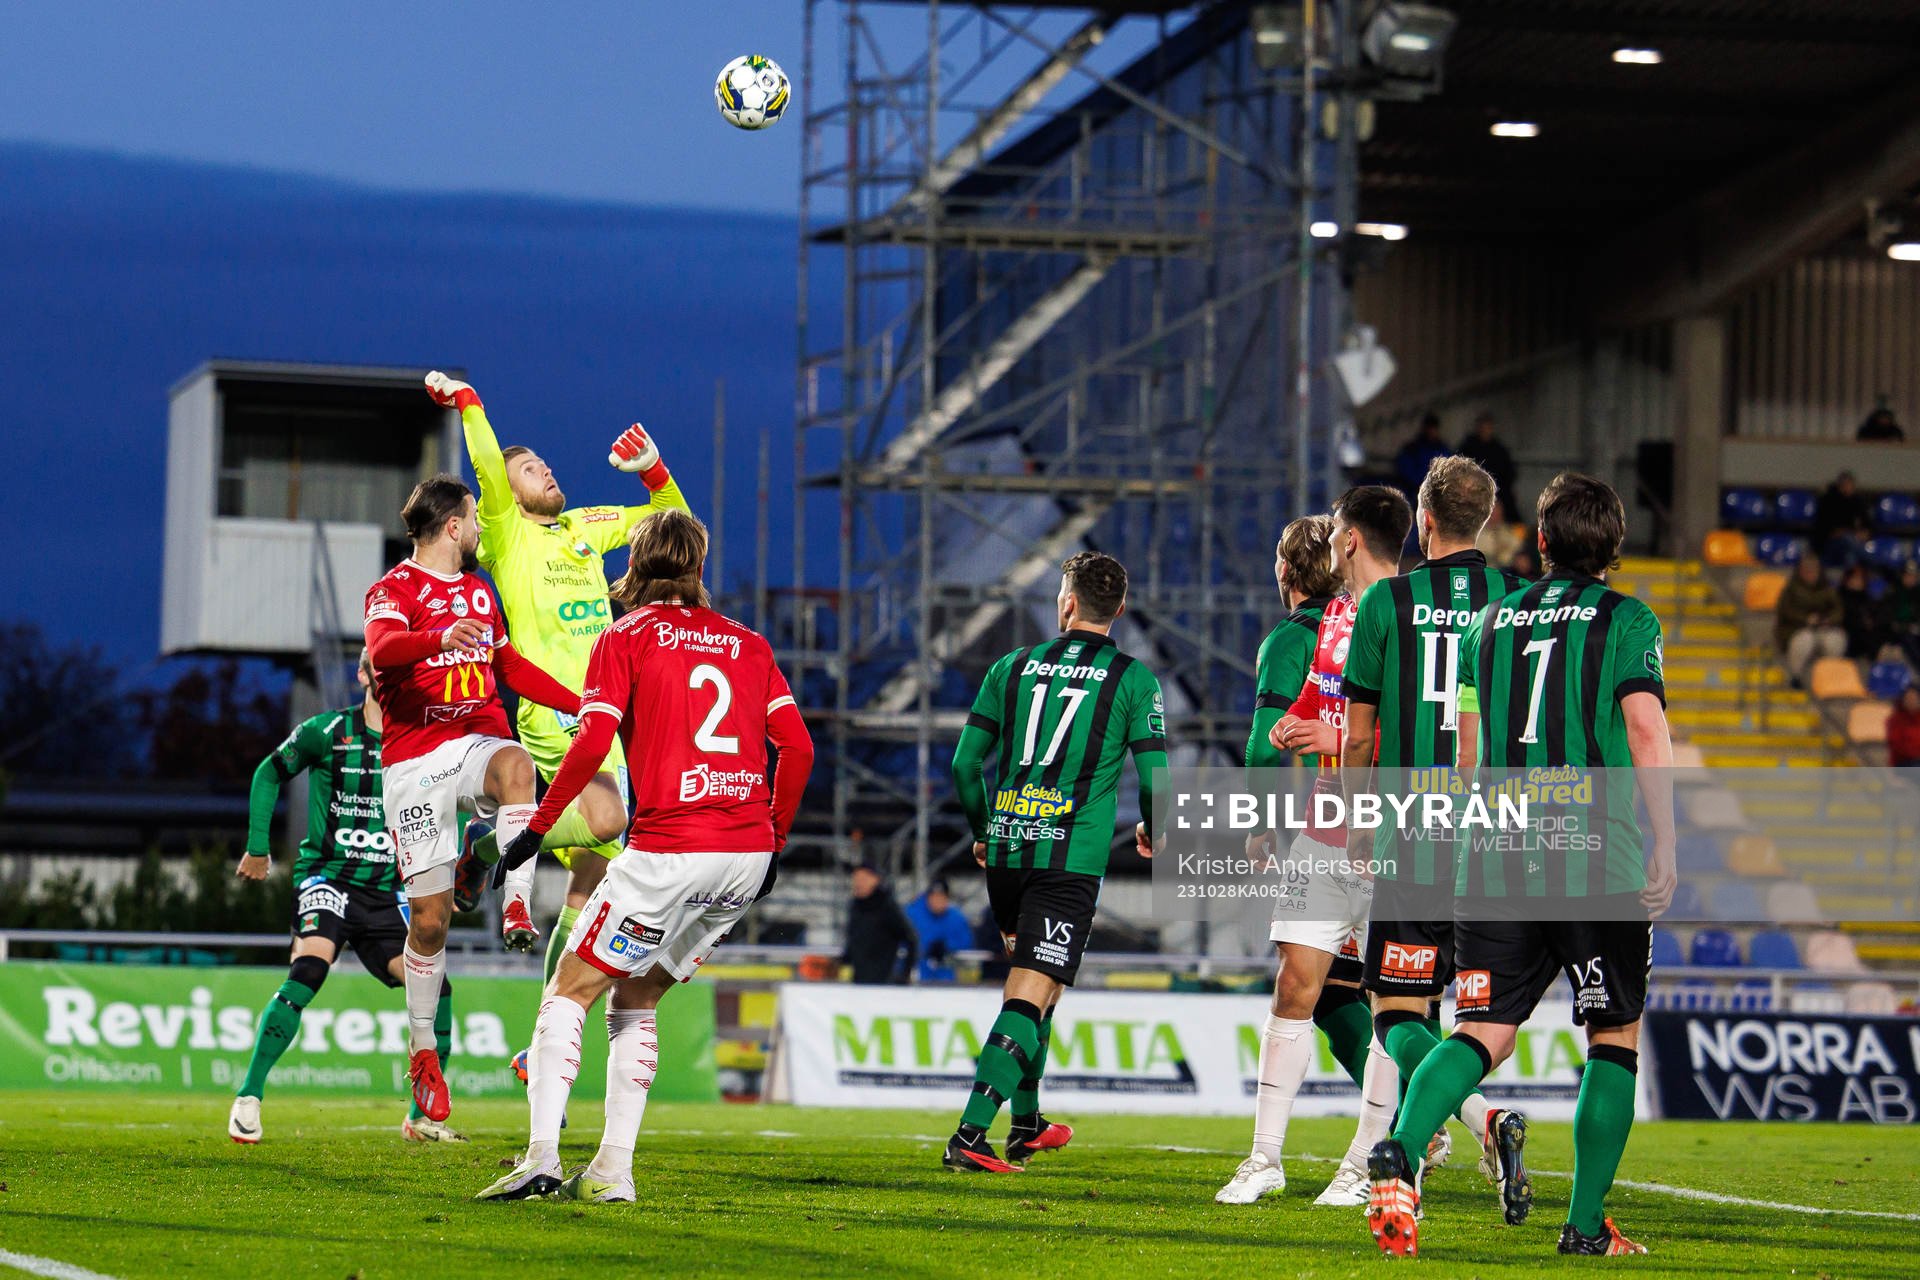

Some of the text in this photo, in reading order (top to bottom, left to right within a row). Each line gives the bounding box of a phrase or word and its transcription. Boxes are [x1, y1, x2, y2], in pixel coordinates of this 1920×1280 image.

[543, 576, 592, 587] Sparbank
[1412, 604, 1479, 627] Dero
[1493, 605, 1598, 630] Derome
[570, 622, 611, 637] VARBE
[653, 621, 743, 660] Björnberg
[684, 643, 724, 655] IT-PARTNER
[1021, 660, 1108, 682] Derome
[1421, 631, 1462, 731] 4
[688, 663, 740, 755] 2
[1018, 683, 1090, 767] 17
[1528, 764, 1579, 785] Gekås
[336, 790, 383, 807] Varbergs
[709, 783, 753, 800] Energi
[1021, 783, 1063, 802] Gekås
[1487, 775, 1593, 810] Ullared
[330, 802, 381, 819] Sparbank
[995, 790, 1074, 817] Ullared
[986, 821, 1066, 841] WELLNESS
[1490, 815, 1580, 835] NORDIC
[1473, 834, 1602, 852] WELLNESS
[345, 849, 395, 864] VARBERG
[622, 920, 661, 940] SEQURITY
[1044, 917, 1074, 945] VS
[1033, 946, 1069, 962] STADSHOTELL
[1040, 941, 1068, 954] VARBERGS
[1384, 944, 1435, 970] FMP
[1571, 956, 1603, 988] VS
[834, 1014, 984, 1070] MTA
[1047, 1020, 1198, 1078] MTA
[1686, 1018, 1897, 1075] NORRA
[1837, 1075, 1917, 1124] AB
